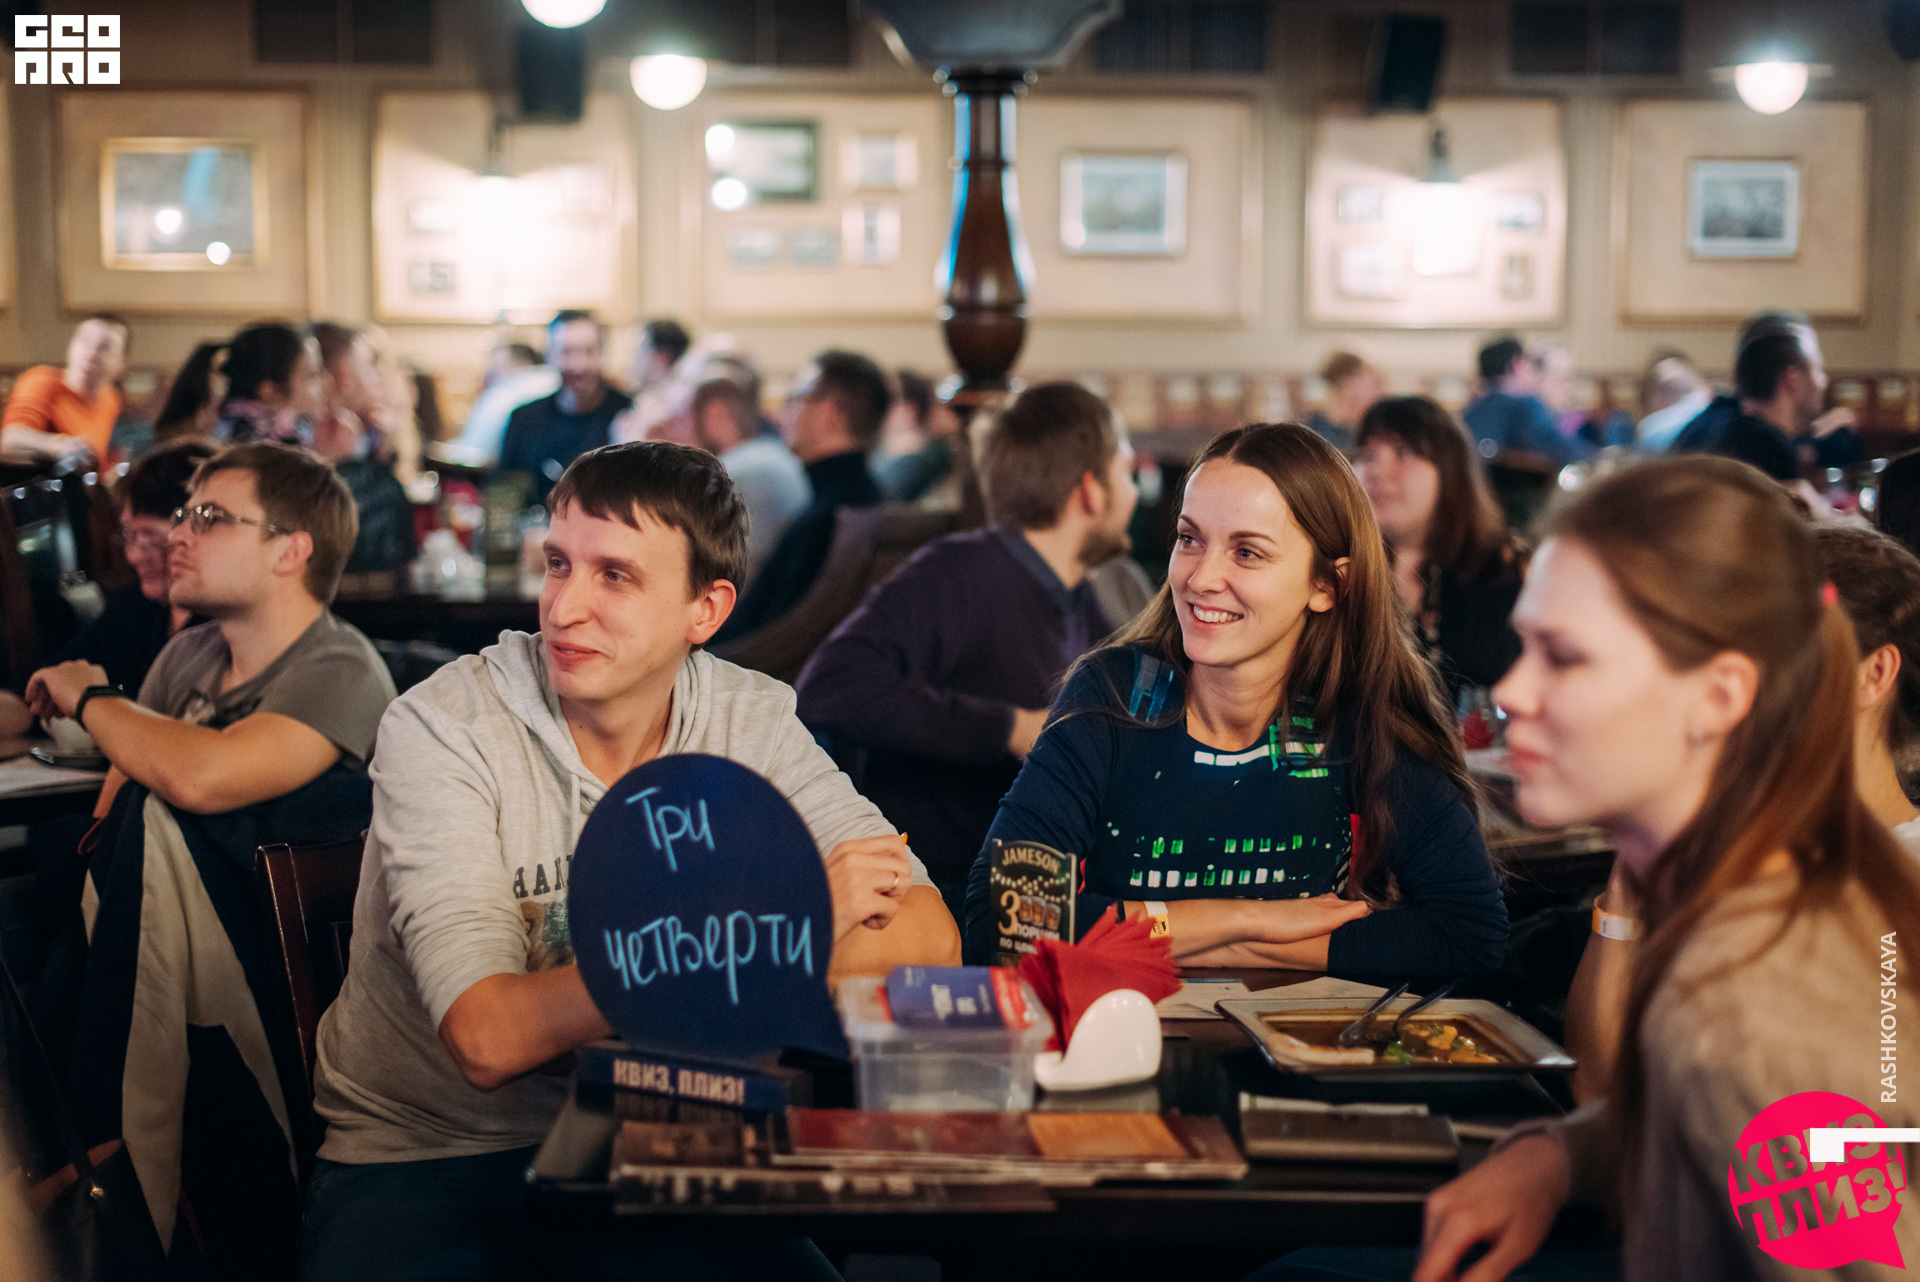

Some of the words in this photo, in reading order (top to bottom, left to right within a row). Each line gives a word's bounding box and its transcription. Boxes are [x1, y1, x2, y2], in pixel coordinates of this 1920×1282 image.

[625, 786, 715, 872] Три
[1001, 847, 1060, 876] JAMESON
[998, 889, 1020, 935] 3
[677, 1068, 746, 1106] ПЛИЗ!
